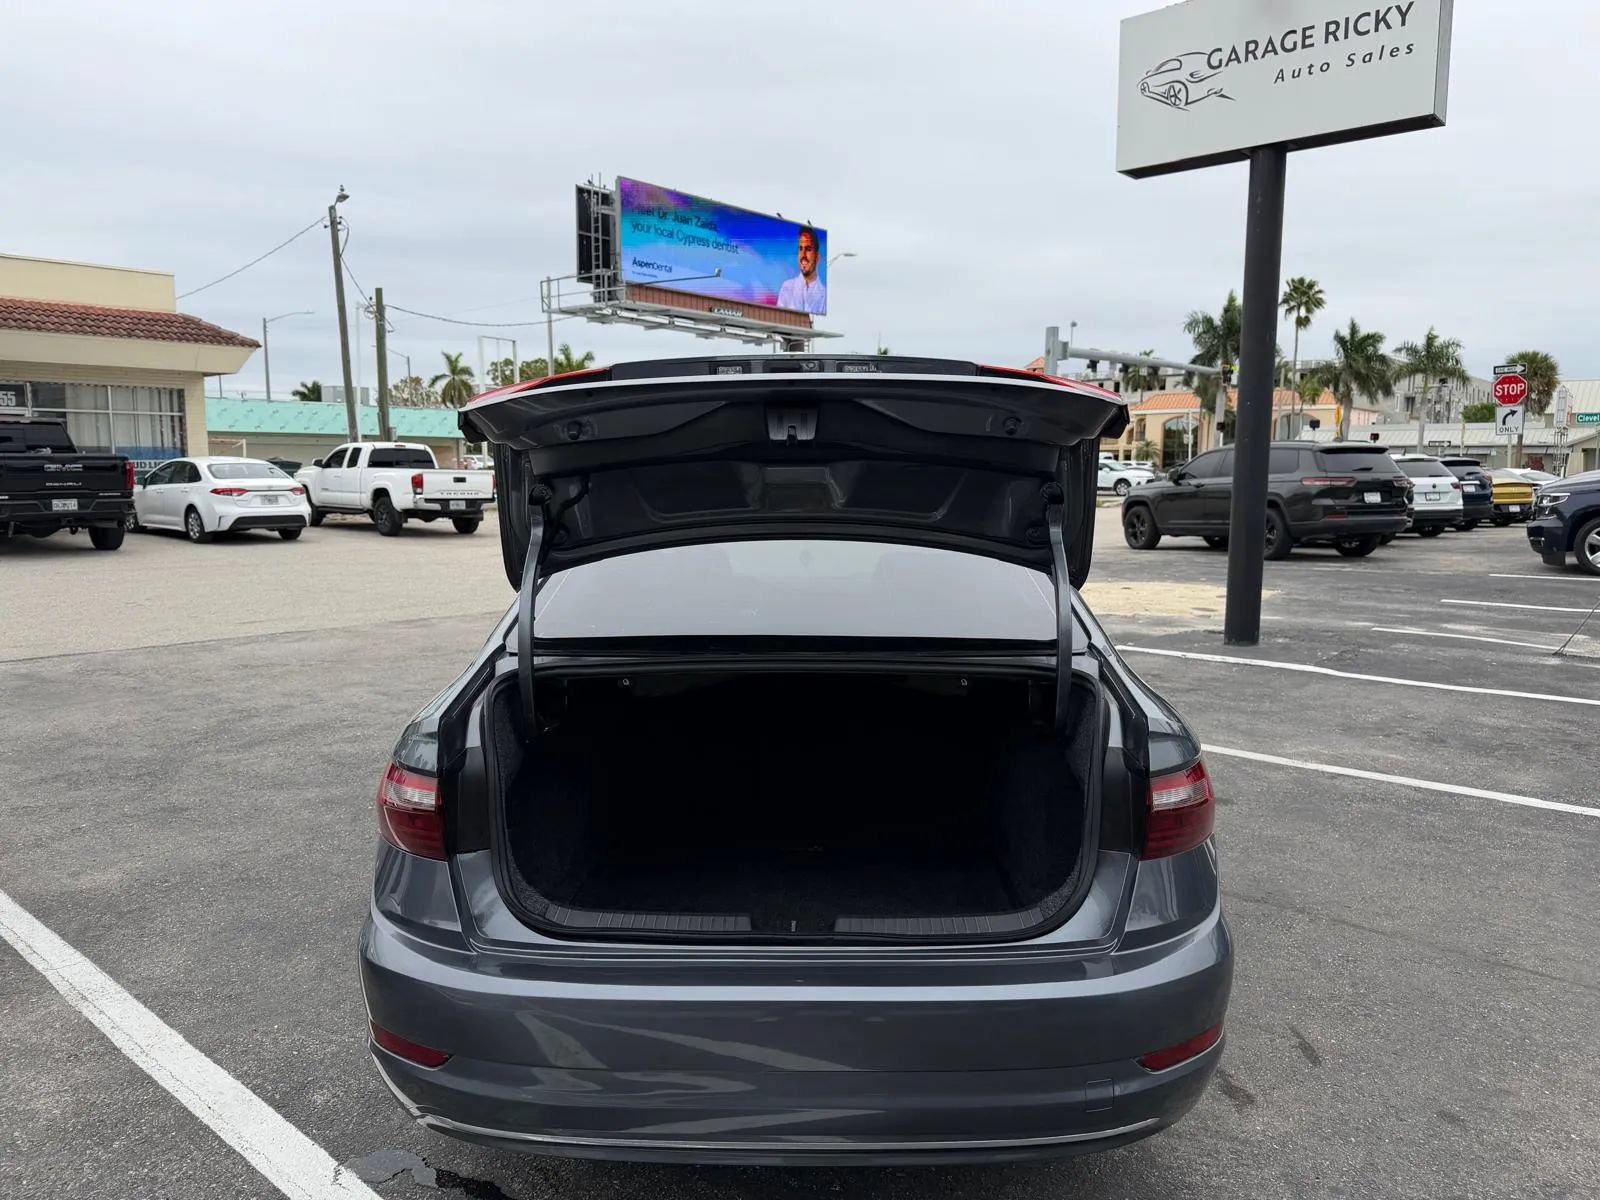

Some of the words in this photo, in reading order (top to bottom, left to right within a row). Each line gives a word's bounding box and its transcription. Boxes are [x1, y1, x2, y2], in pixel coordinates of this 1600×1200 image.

[1206, 24, 1316, 70] GARAGE
[1324, 1, 1414, 44] RICKY
[1274, 61, 1330, 84] Auto
[1346, 43, 1414, 67] Sales
[632, 222, 652, 234] your
[655, 224, 674, 239] local
[677, 230, 710, 248] Cypress
[1495, 383, 1525, 396] STOP
